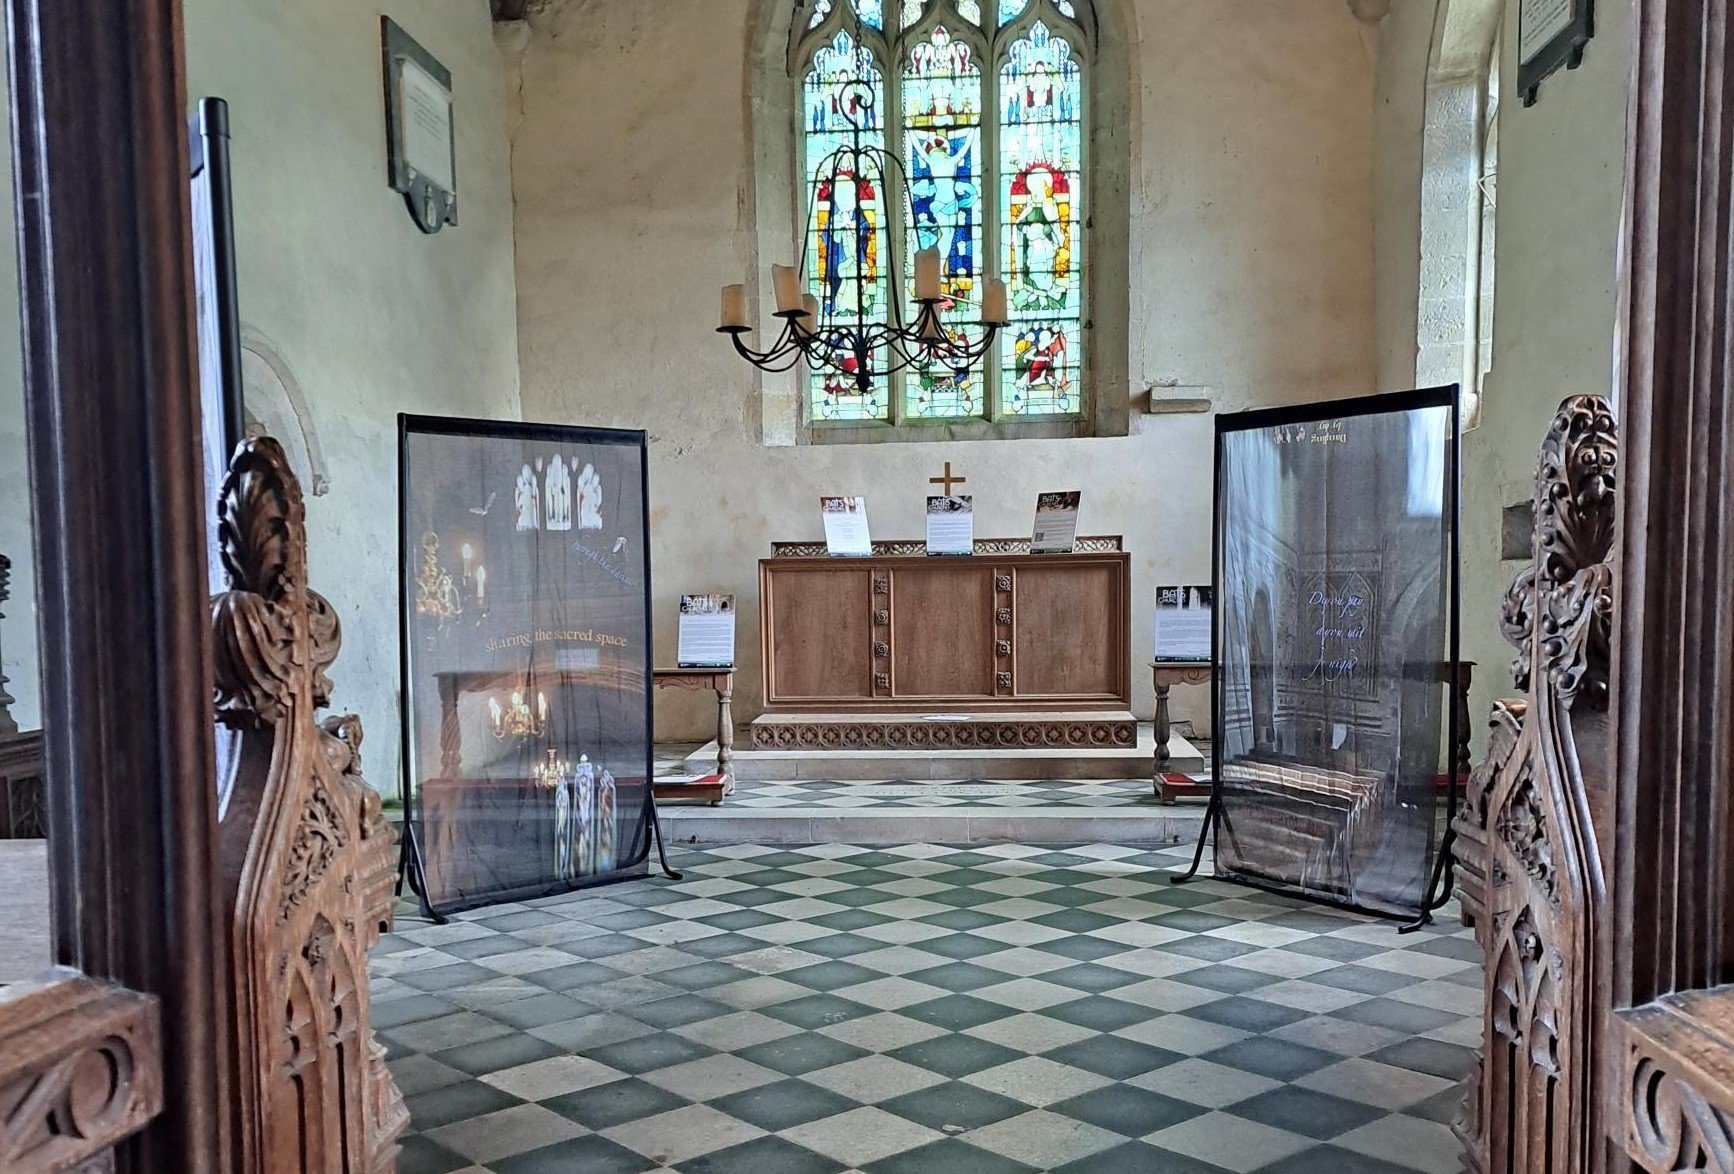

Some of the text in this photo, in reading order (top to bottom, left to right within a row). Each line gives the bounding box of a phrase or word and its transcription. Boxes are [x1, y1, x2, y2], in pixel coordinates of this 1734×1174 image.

[485, 628, 627, 652] sharing the sacred space
